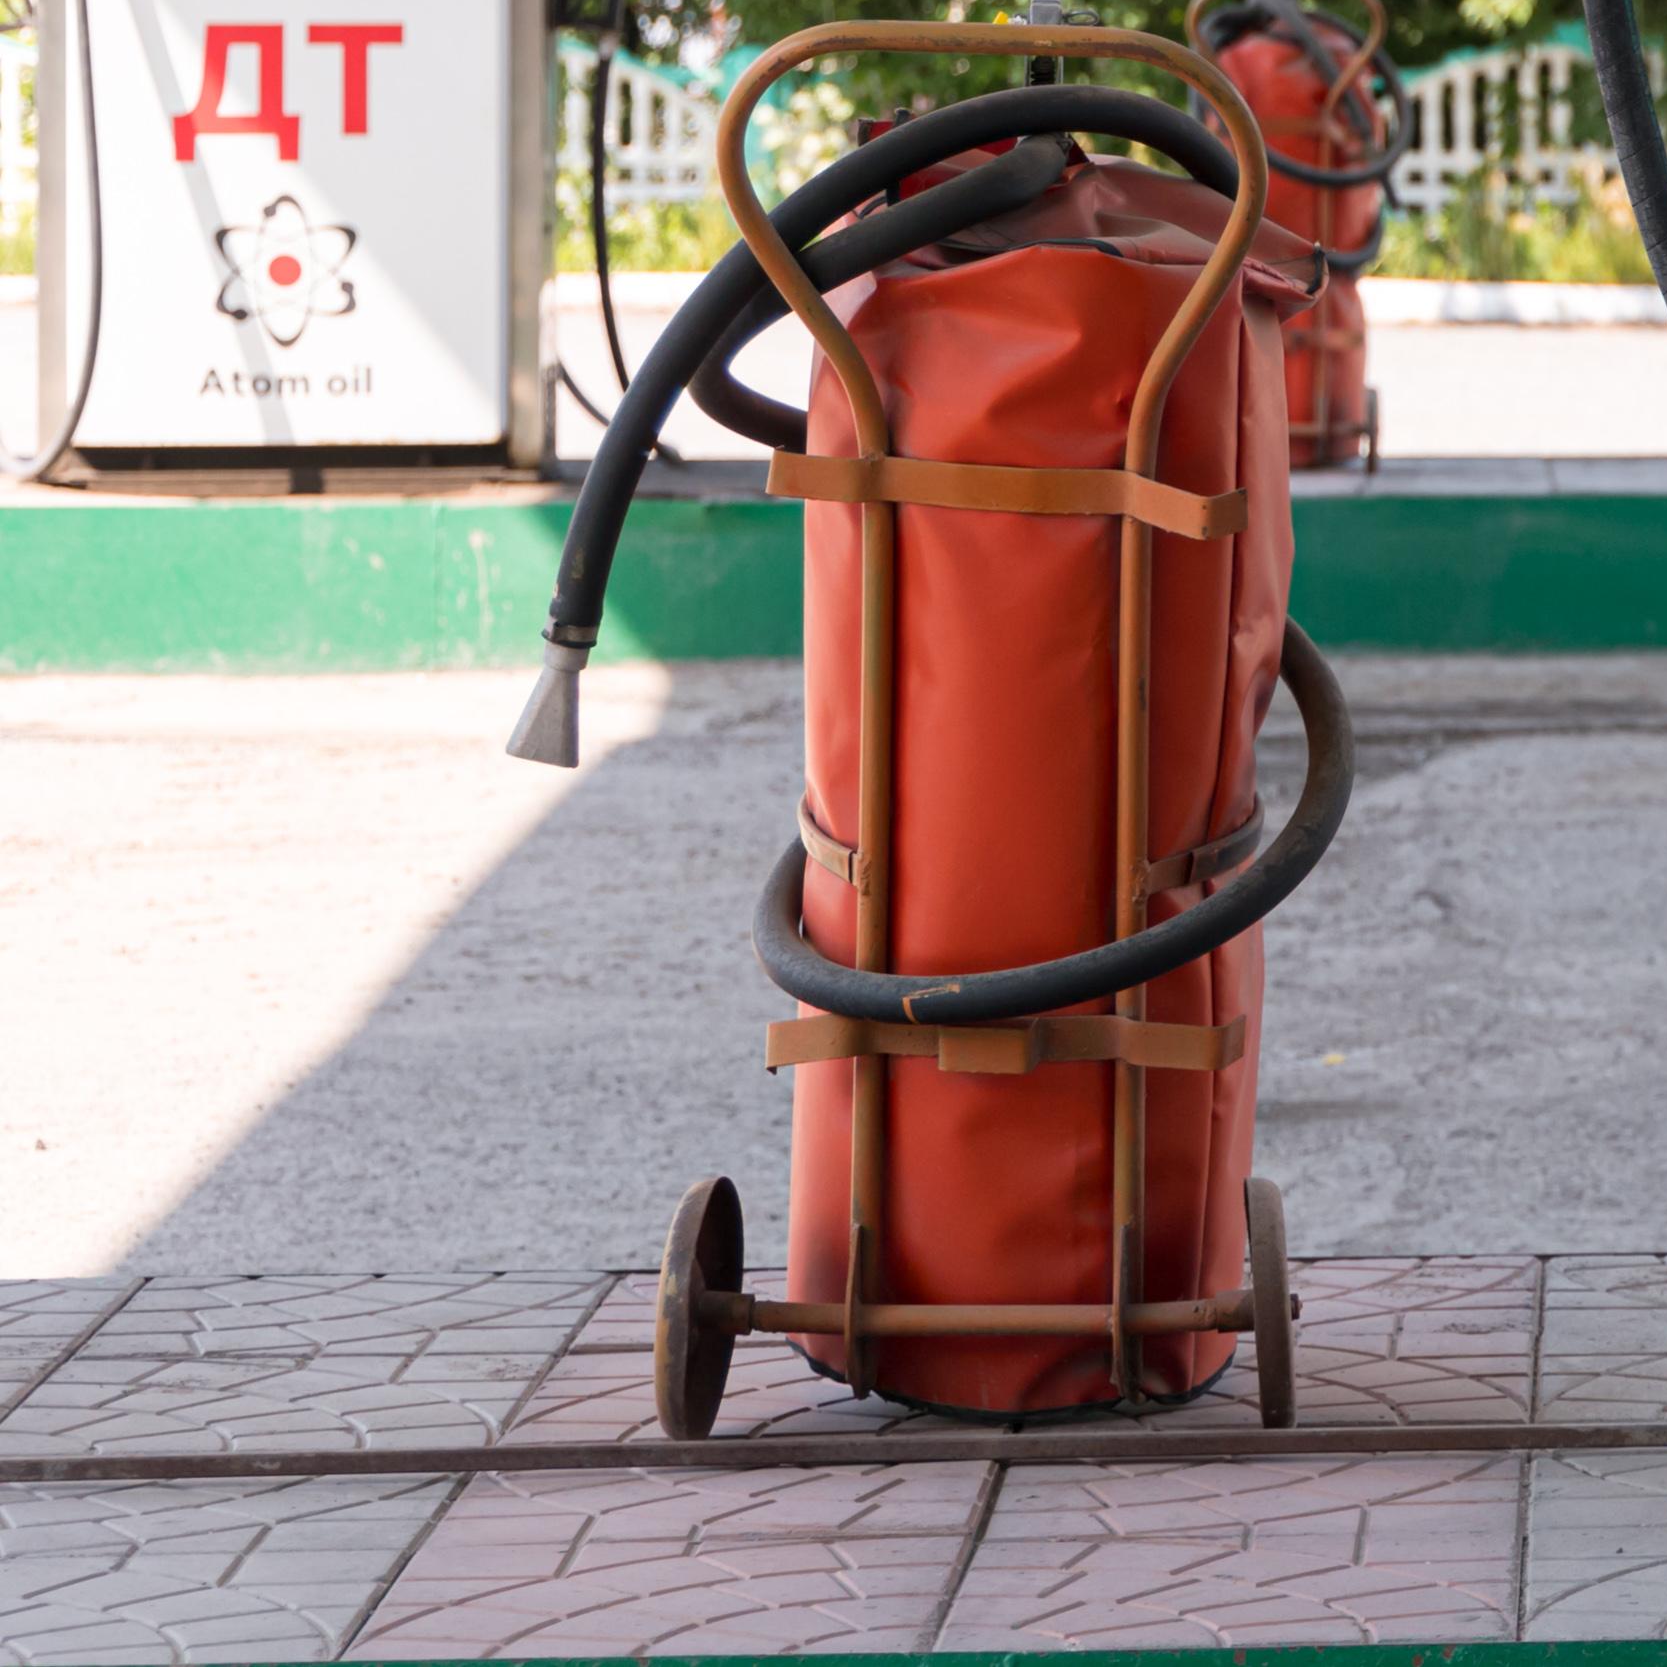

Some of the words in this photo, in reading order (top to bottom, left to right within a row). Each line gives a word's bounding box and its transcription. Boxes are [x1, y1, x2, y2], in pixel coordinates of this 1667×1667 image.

[172, 23, 404, 162] ДТ
[199, 368, 310, 396] Atom
[326, 365, 372, 394] oil
